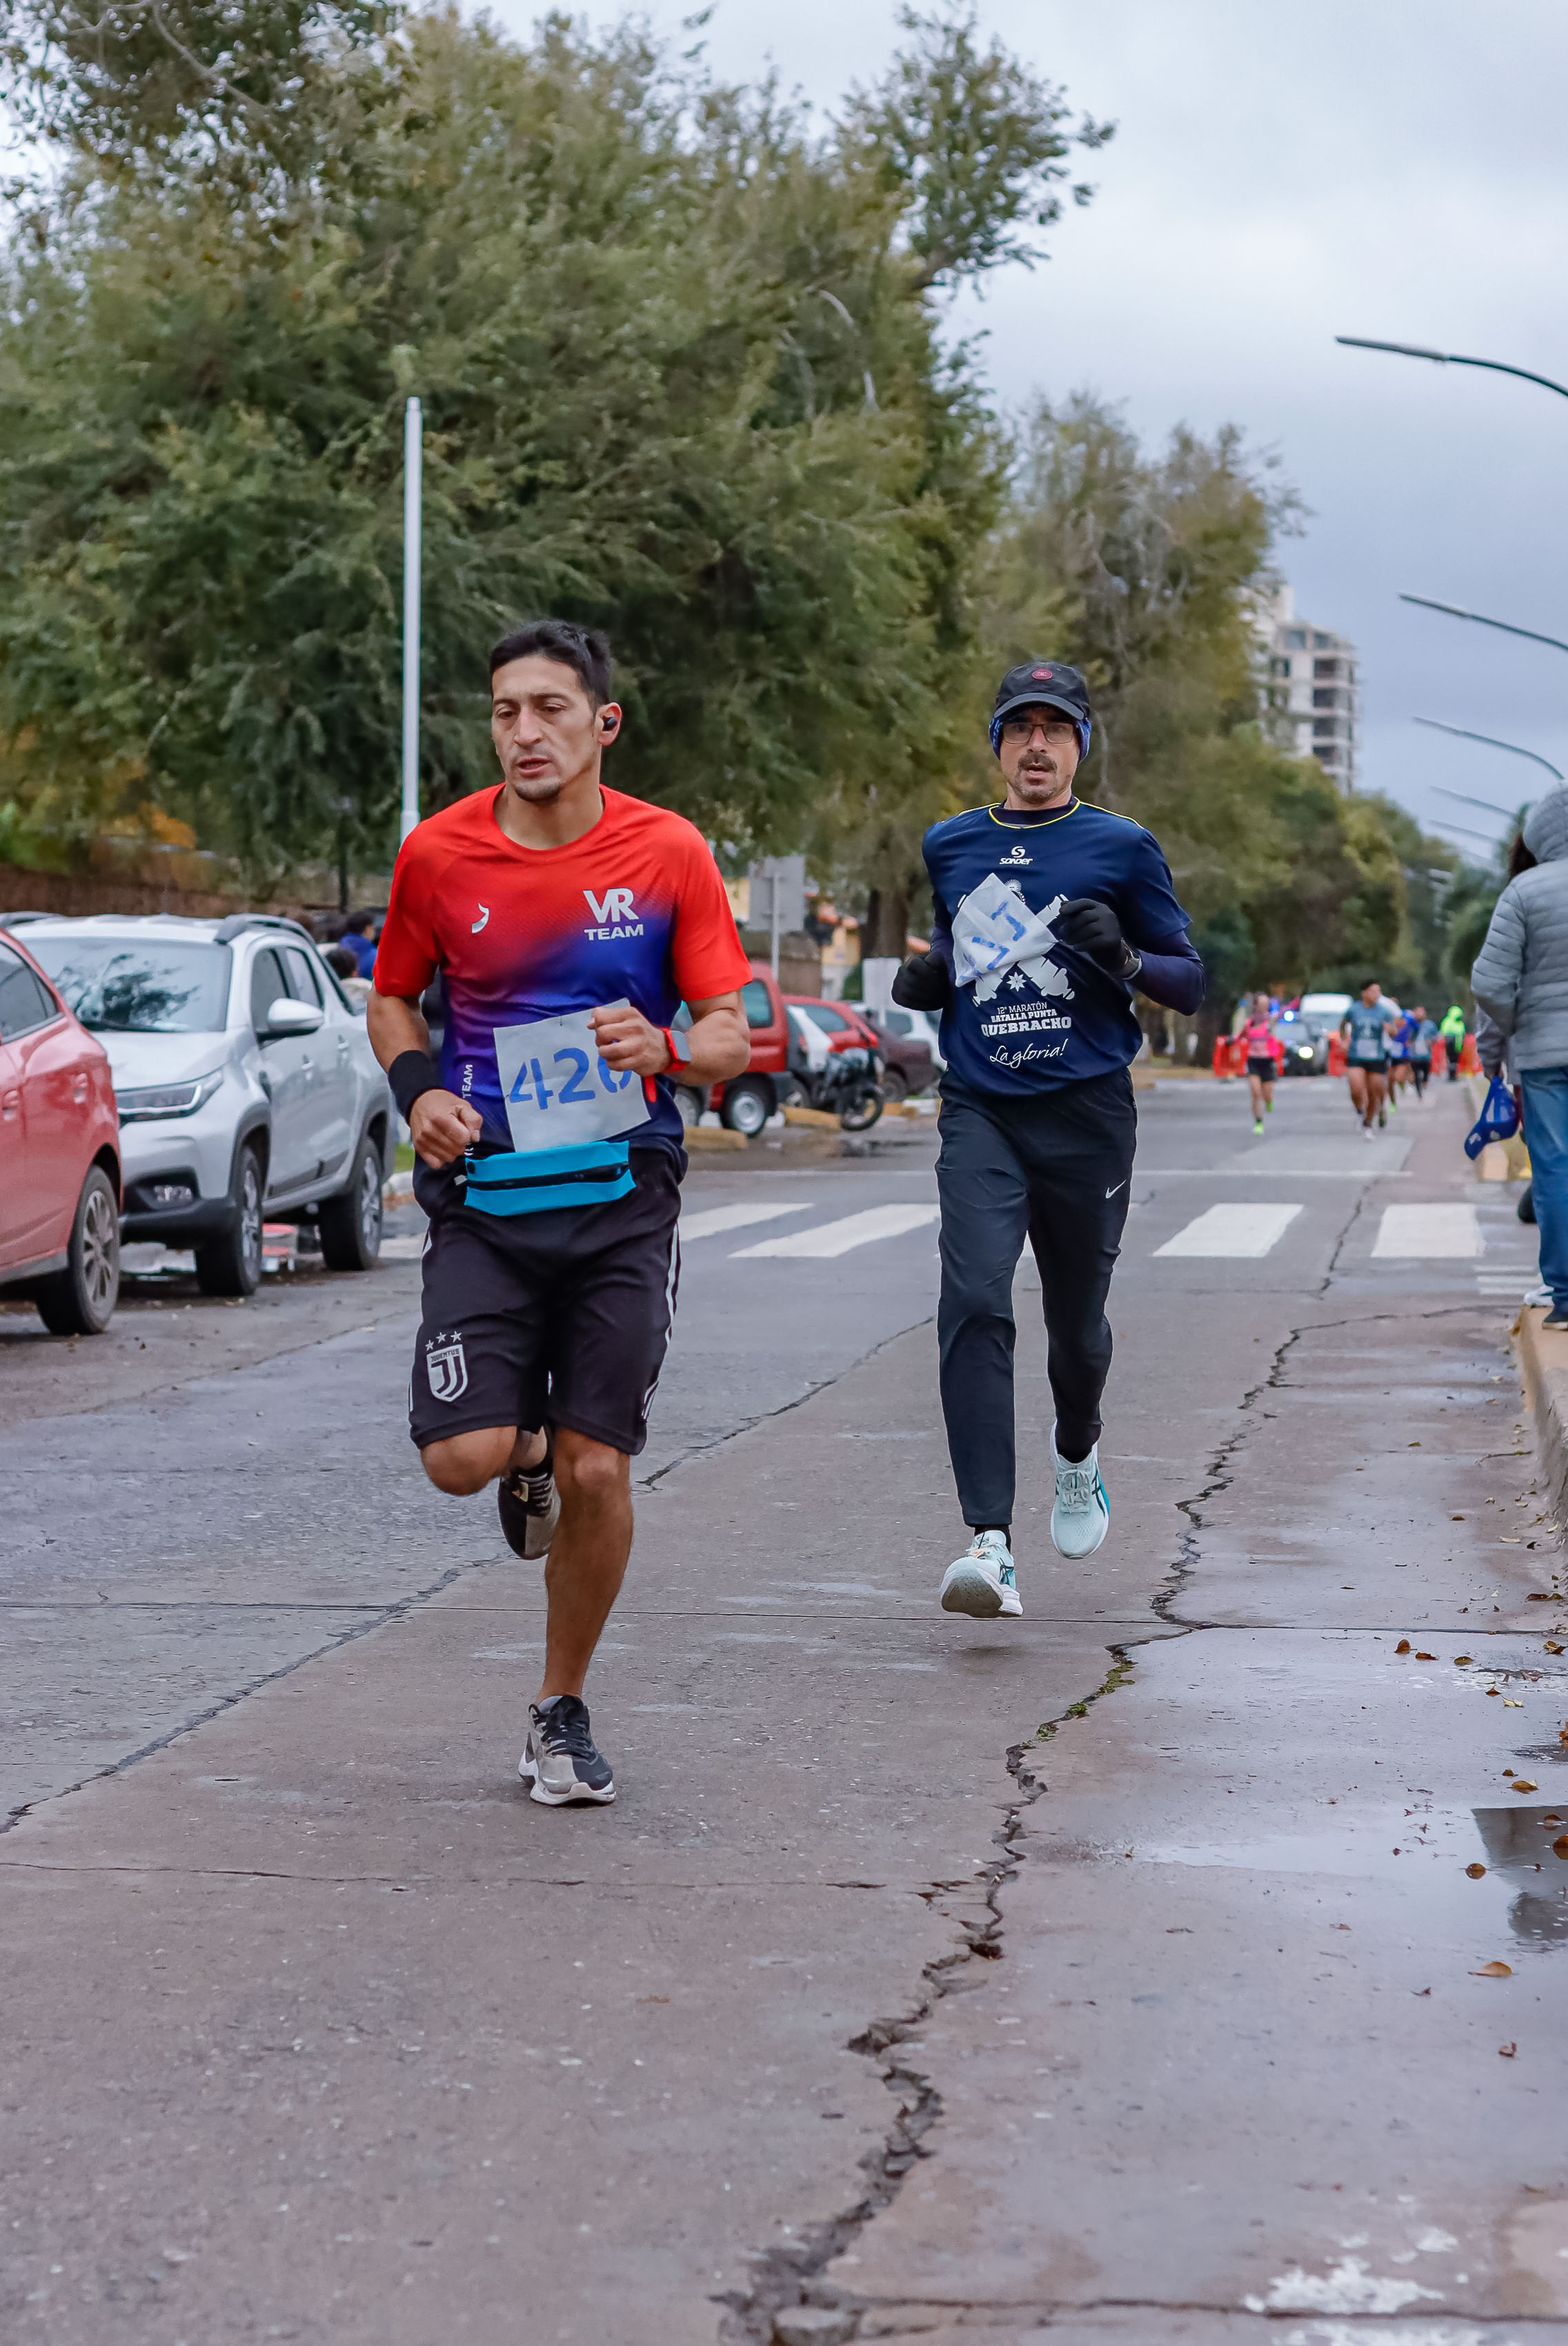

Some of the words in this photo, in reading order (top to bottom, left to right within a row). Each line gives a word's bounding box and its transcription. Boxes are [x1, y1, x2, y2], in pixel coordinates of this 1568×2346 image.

[583, 887, 639, 924] VR
[584, 924, 644, 941] TEAM
[991, 1013, 1028, 1023] BATALLA
[1027, 1008, 1058, 1019] PUNTA
[1009, 1001, 1048, 1013] MARATÓN
[981, 1016, 1071, 1037] QUEBRACHO
[989, 1045, 1010, 1065] La
[1010, 1038, 1069, 1068] gloria!
[462, 1064, 473, 1099] TEAM
[430, 1349, 459, 1362] JUVENTUS
